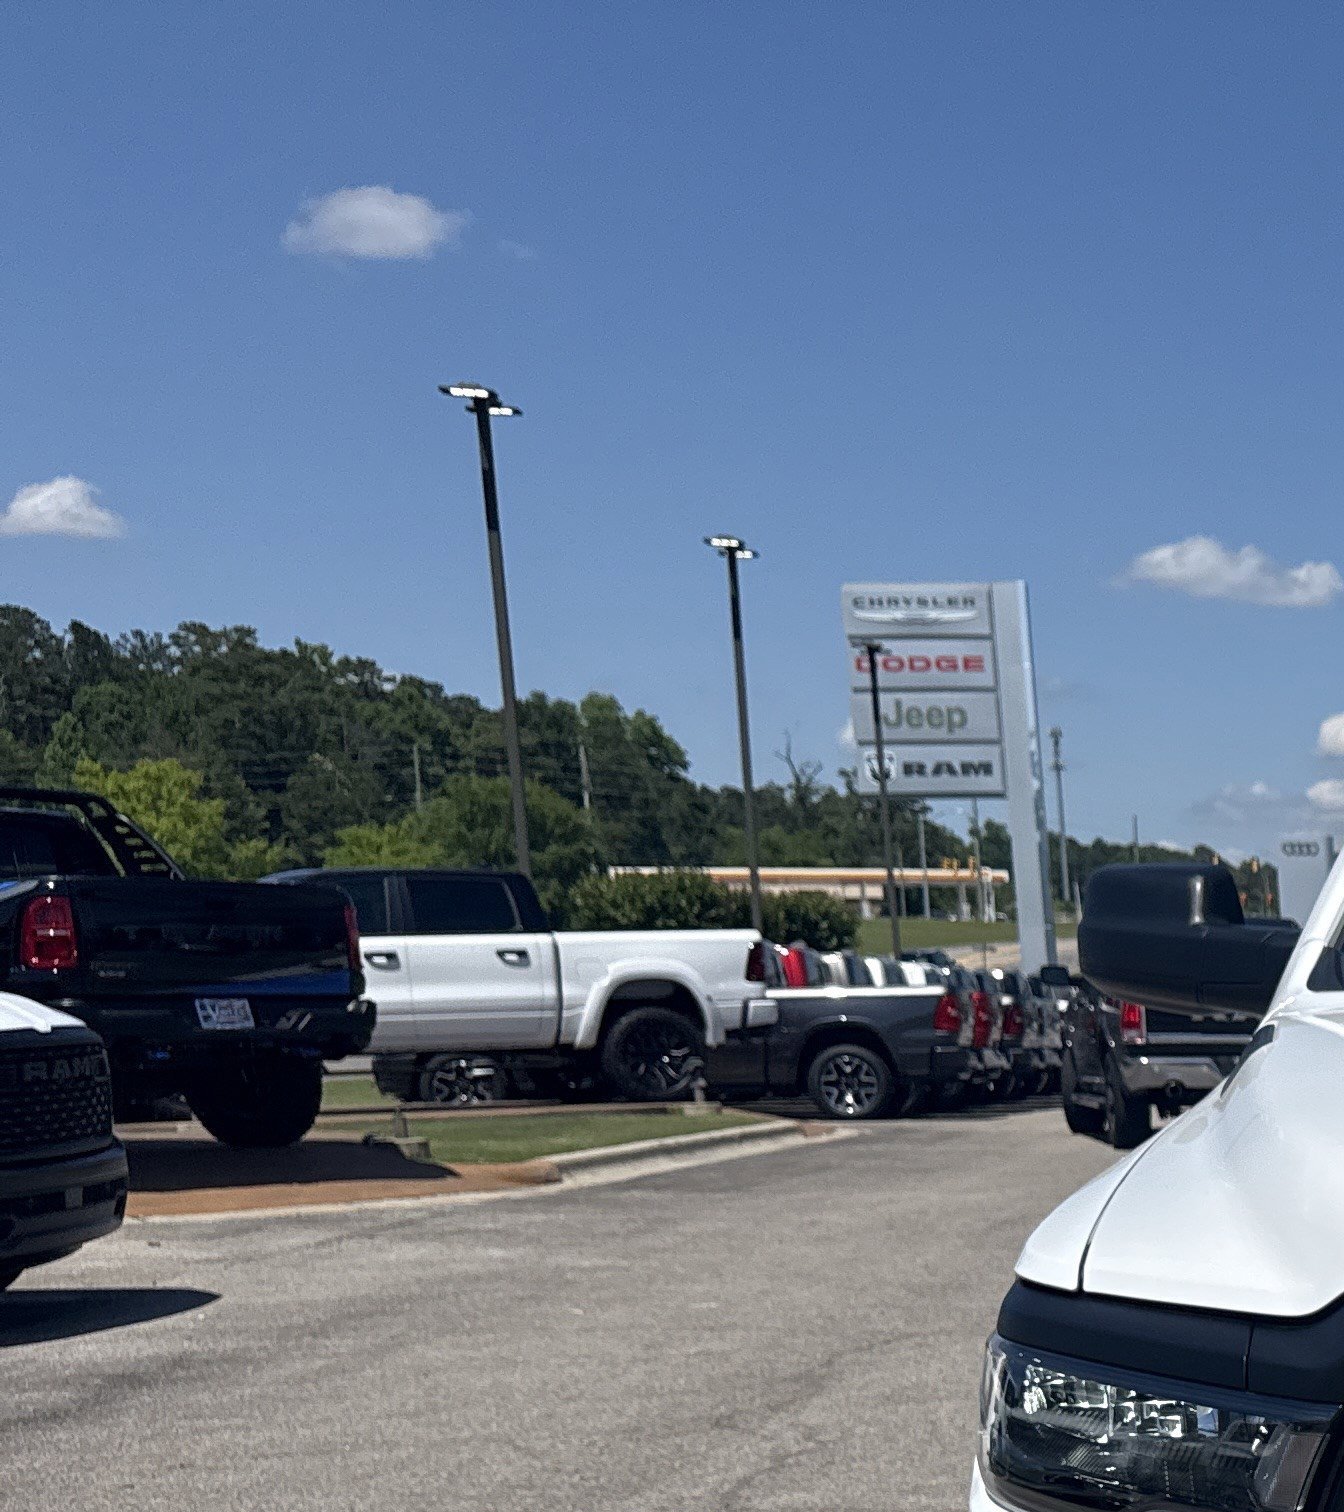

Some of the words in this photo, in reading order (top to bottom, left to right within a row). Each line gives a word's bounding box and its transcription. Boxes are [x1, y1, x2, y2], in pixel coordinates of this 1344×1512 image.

[852, 596, 976, 609] CHRYSLER
[883, 699, 968, 733] Jeep
[903, 760, 994, 777] RAM
